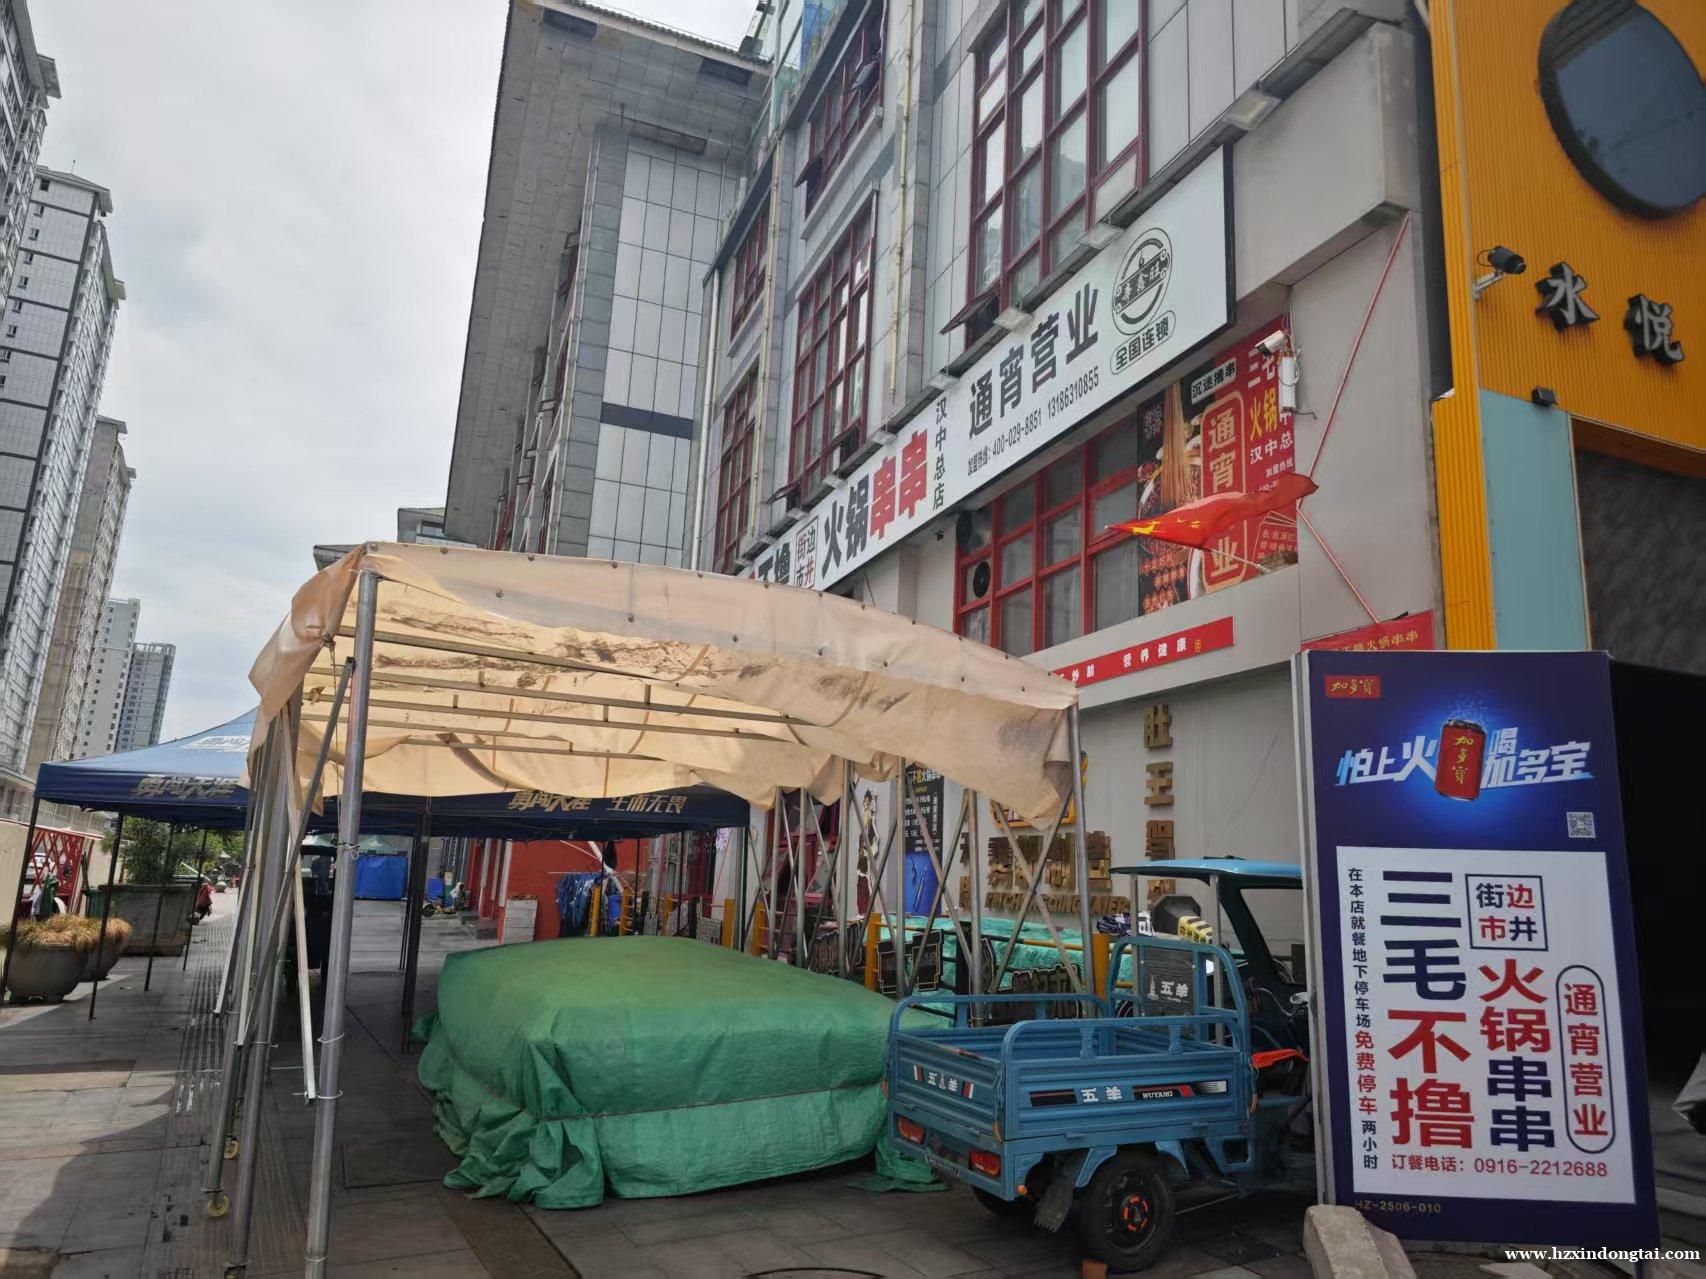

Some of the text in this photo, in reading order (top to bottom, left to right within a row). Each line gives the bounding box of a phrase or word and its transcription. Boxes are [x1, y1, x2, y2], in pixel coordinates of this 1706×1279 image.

[969, 283, 1099, 440] 通宵营业
[1115, 317, 1169, 369] 全国连锁
[1536, 262, 1685, 364] 水悦
[1048, 366, 1099, 419] 13186310855
[933, 396, 947, 510] 汉中总店
[1208, 407, 1239, 576] 通宵业
[1250, 431, 1294, 465] 汉中总
[821, 428, 928, 580] 火锅串串
[606, 795, 688, 814] 生而无畏
[1476, 882, 1535, 910] 街边
[1479, 915, 1538, 942] 市井
[1380, 870, 1475, 1150] 三毛不撸
[1478, 958, 1556, 1152] 火锅串串
[1563, 982, 1609, 1137] 通宵营业
[1142, 1090, 1174, 1099] WUYANG
